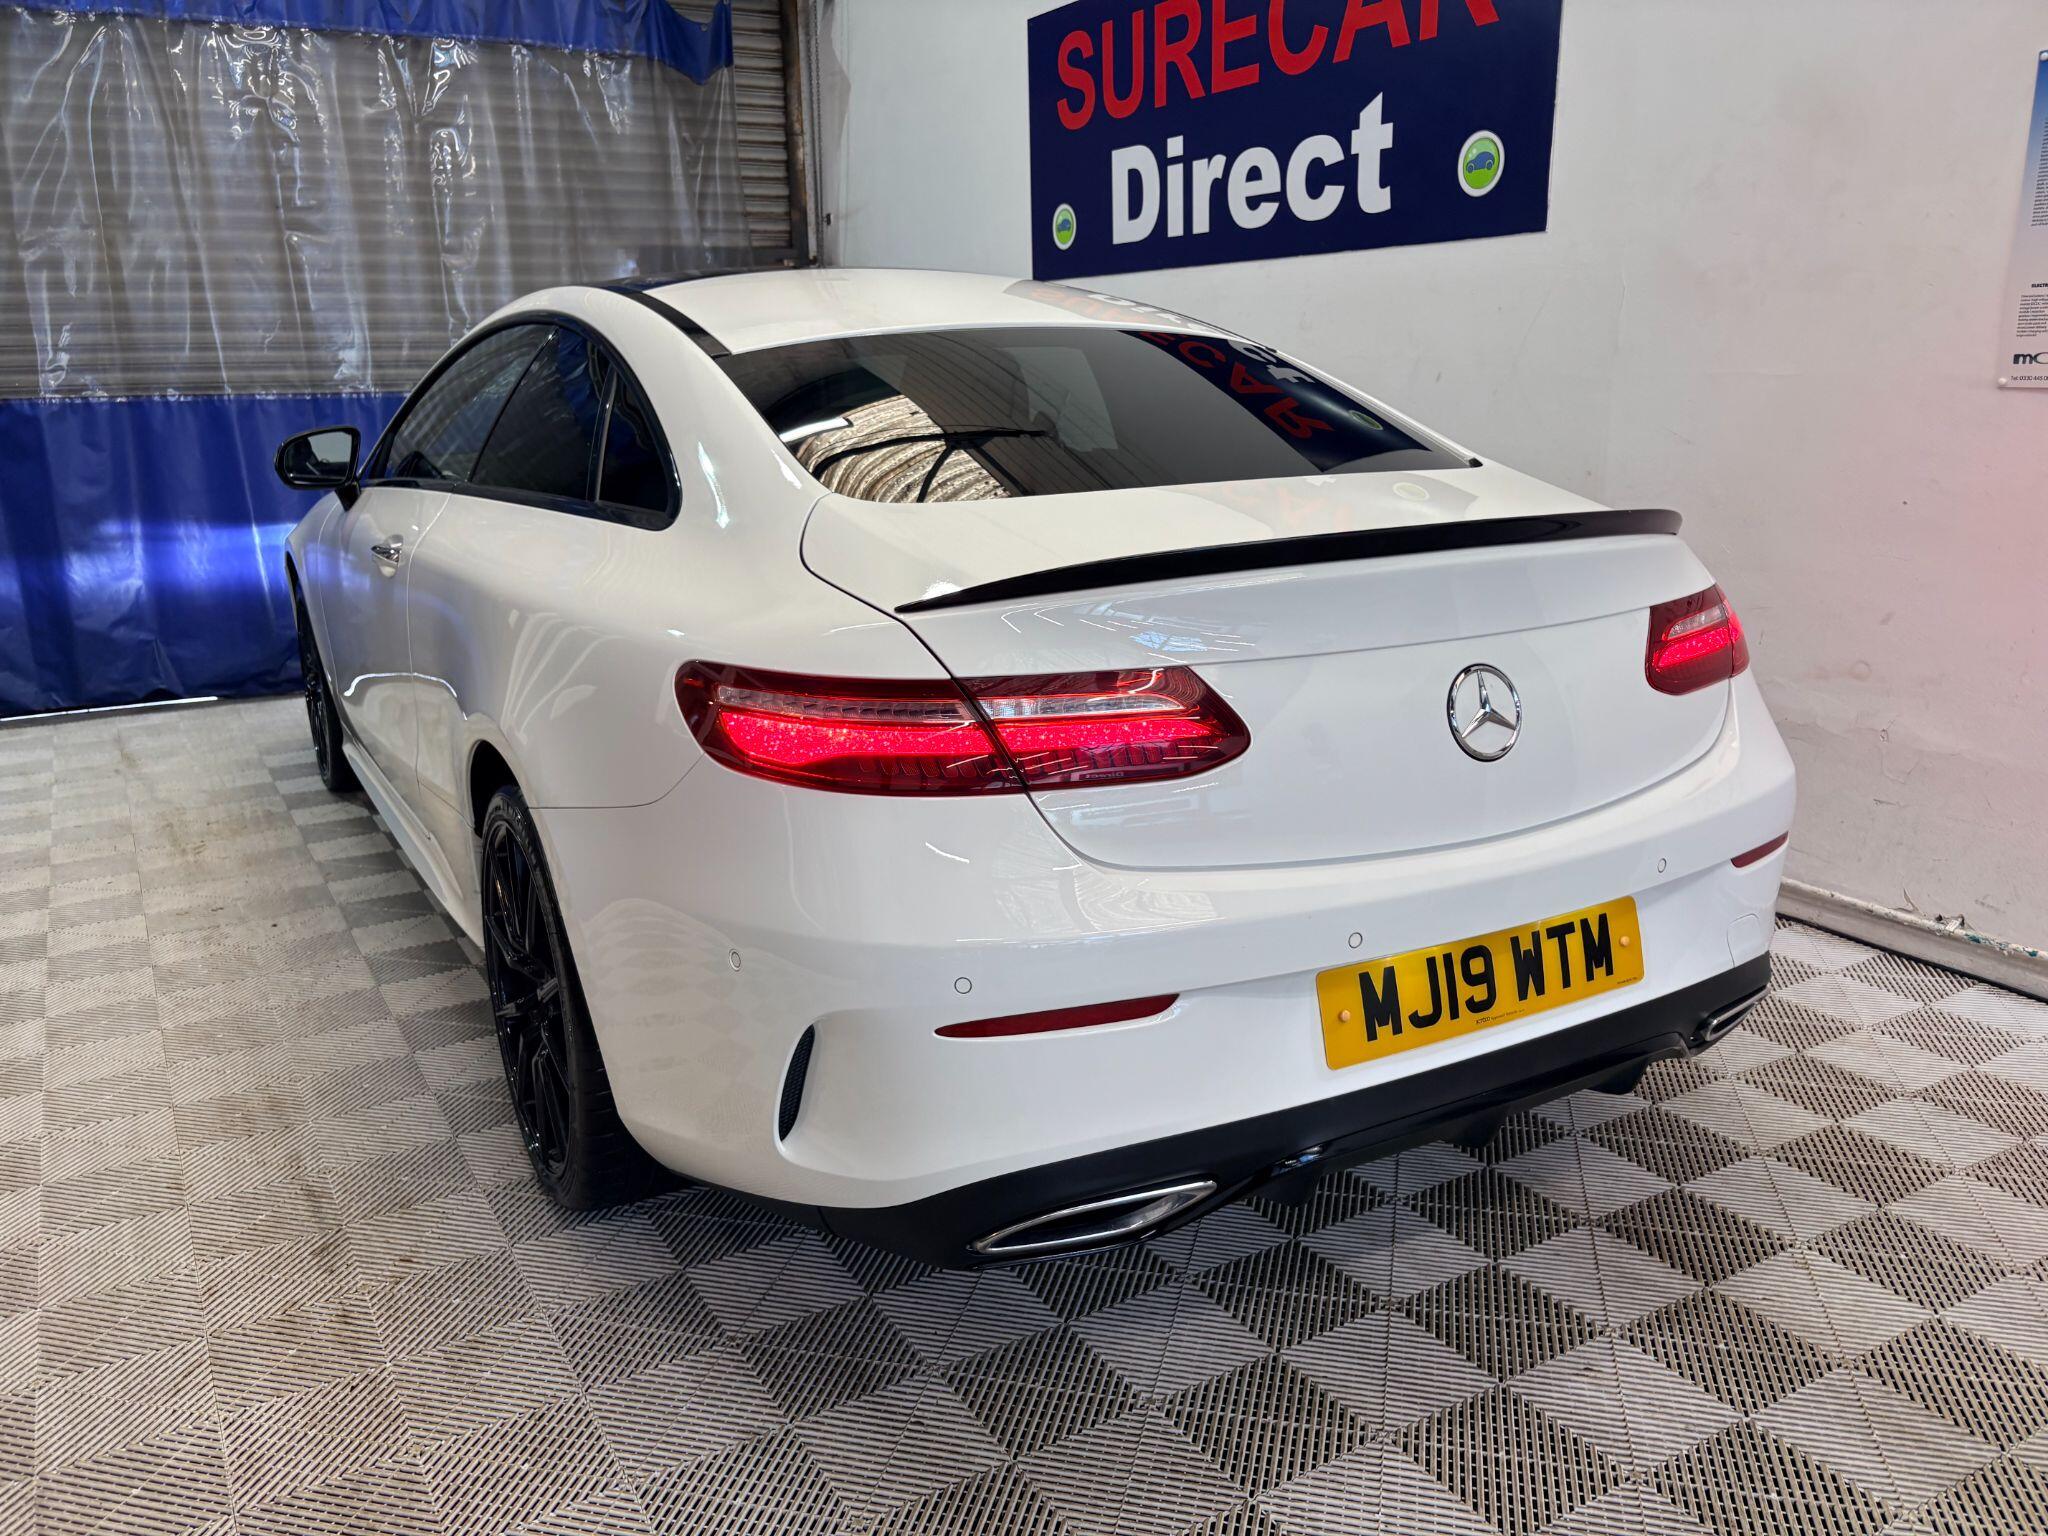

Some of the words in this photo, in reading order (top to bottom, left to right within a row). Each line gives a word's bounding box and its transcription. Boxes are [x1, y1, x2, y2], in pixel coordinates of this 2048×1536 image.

[1111, 92, 1394, 245] Direct
[1358, 944, 1497, 1042] MJ19
[1509, 912, 1614, 1002] WTM
